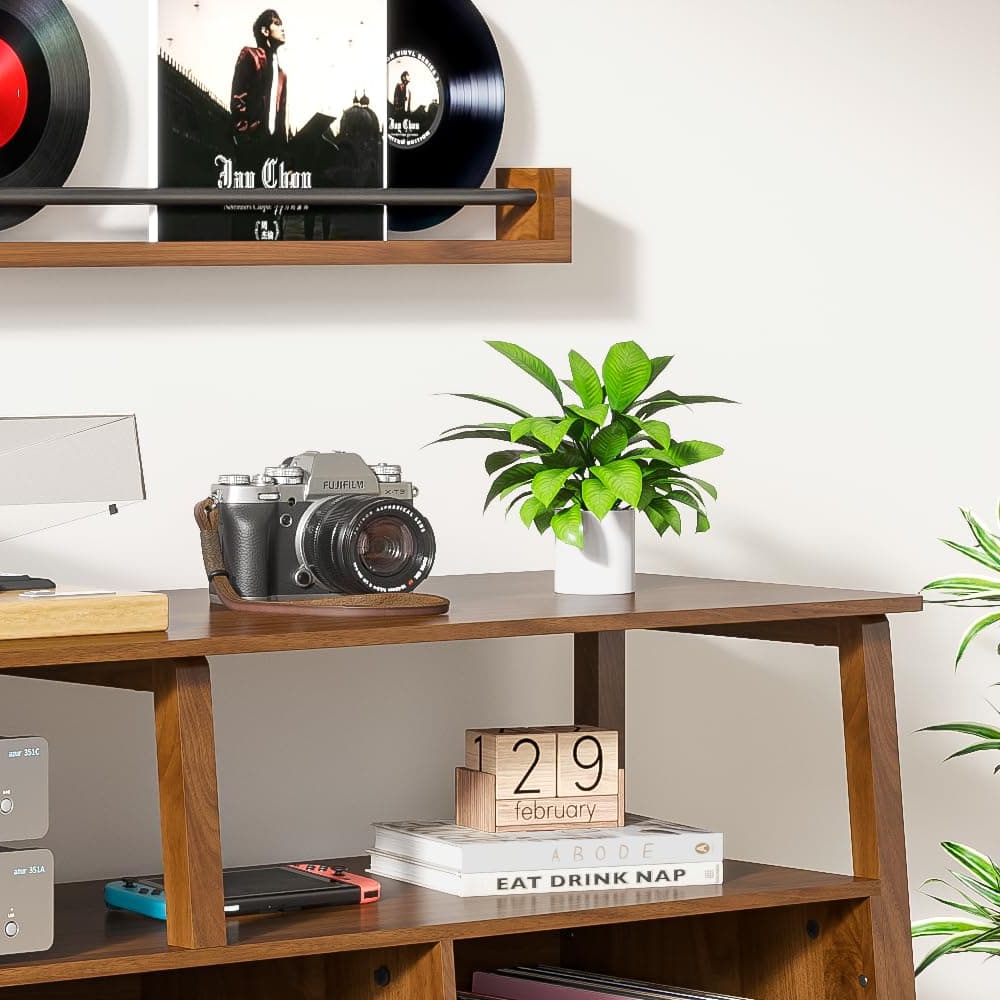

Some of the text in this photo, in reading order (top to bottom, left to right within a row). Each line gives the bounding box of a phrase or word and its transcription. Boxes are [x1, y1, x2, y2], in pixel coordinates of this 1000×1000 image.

[323, 480, 364, 490] FUJIFILM
[23, 748, 40, 757] 351C
[514, 799, 597, 823] february
[28, 865, 46, 874] 351A
[496, 868, 687, 891] EAT DRINK NAP
